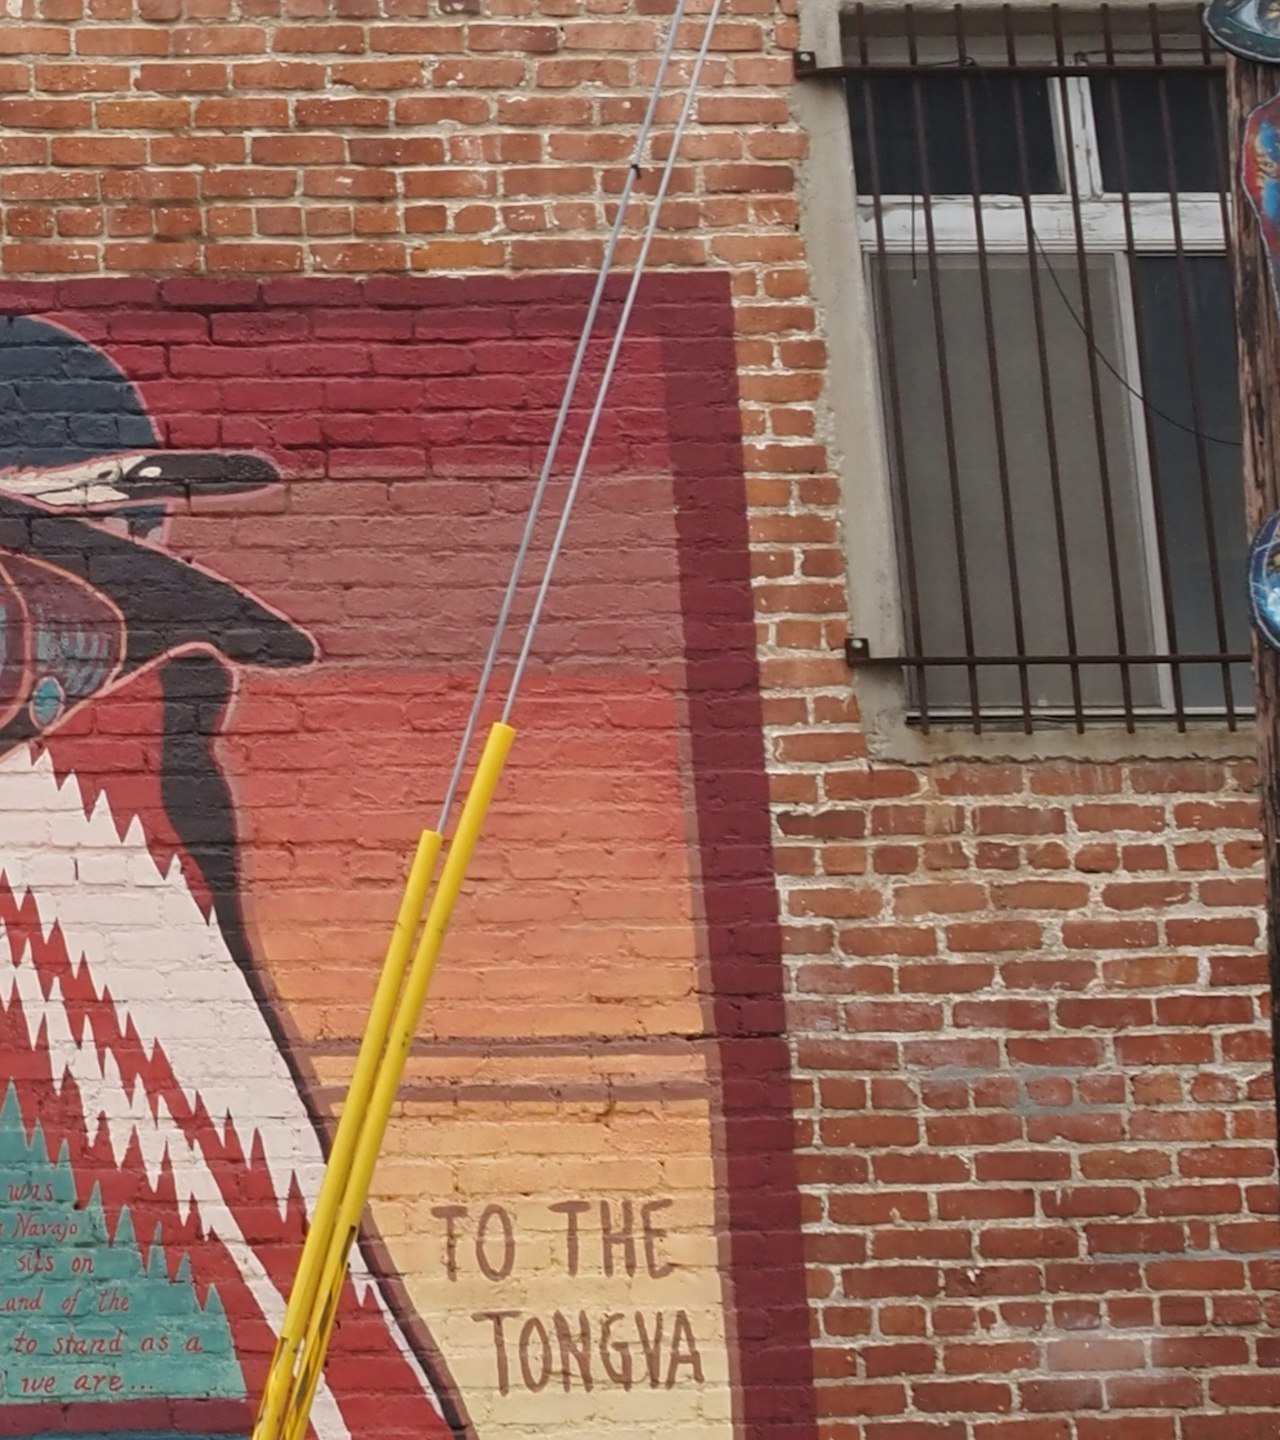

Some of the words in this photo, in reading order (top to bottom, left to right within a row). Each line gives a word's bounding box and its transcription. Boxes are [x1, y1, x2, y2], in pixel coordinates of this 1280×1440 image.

[8, 1182, 54, 1201] was
[12, 1212, 79, 1242] Navajo
[431, 1203, 518, 1283] TO
[548, 1196, 680, 1279] THE
[17, 1250, 55, 1273] sits
[71, 1256, 95, 1273] on
[60, 1289, 82, 1315] of
[97, 1287, 131, 1313] the
[14, 1330, 38, 1355] to
[52, 1328, 123, 1356] stand
[140, 1334, 169, 1353] as
[185, 1335, 203, 1353] a
[471, 1310, 707, 1396] TONGVA
[21, 1374, 57, 1394] we
[74, 1373, 155, 1392] are...
